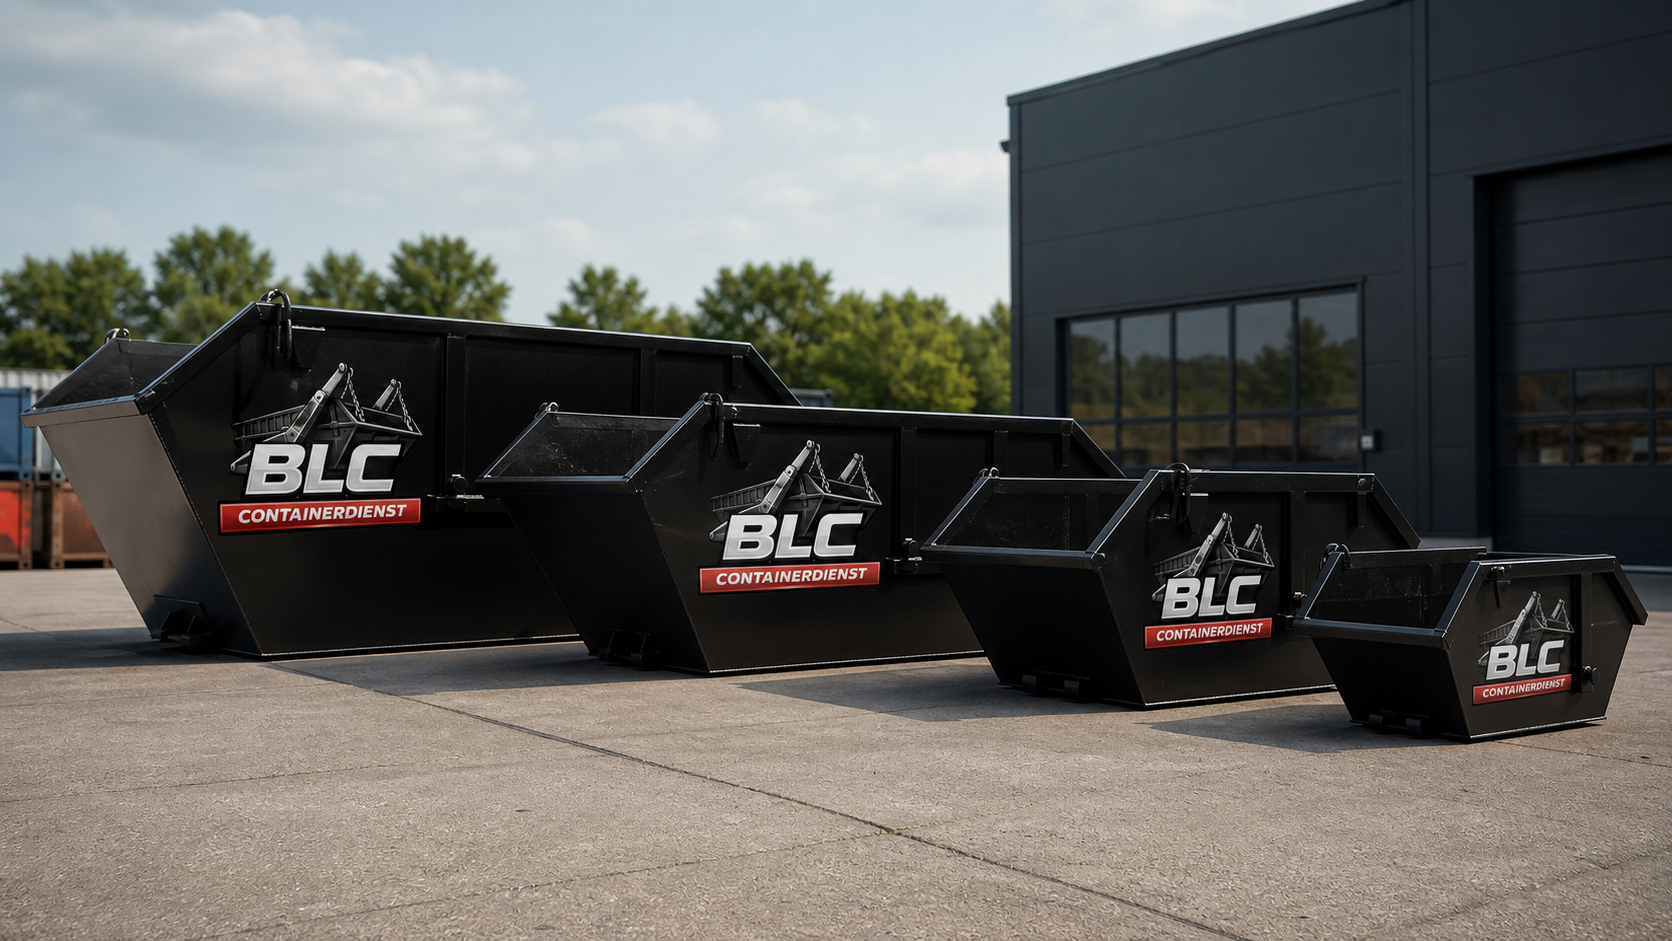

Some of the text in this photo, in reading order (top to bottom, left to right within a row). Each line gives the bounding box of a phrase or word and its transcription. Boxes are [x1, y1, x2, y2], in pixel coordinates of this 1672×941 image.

[245, 443, 402, 495] BLC
[238, 504, 407, 524] CONTAINERDIENST
[722, 513, 864, 560] BLC
[716, 566, 868, 586] CONTAINERDIENST
[1161, 575, 1261, 619] BLC
[1156, 622, 1263, 641] CONTAINERDIENST
[1486, 640, 1564, 680] BLC
[1482, 678, 1565, 698] CONTAINERDIENST
